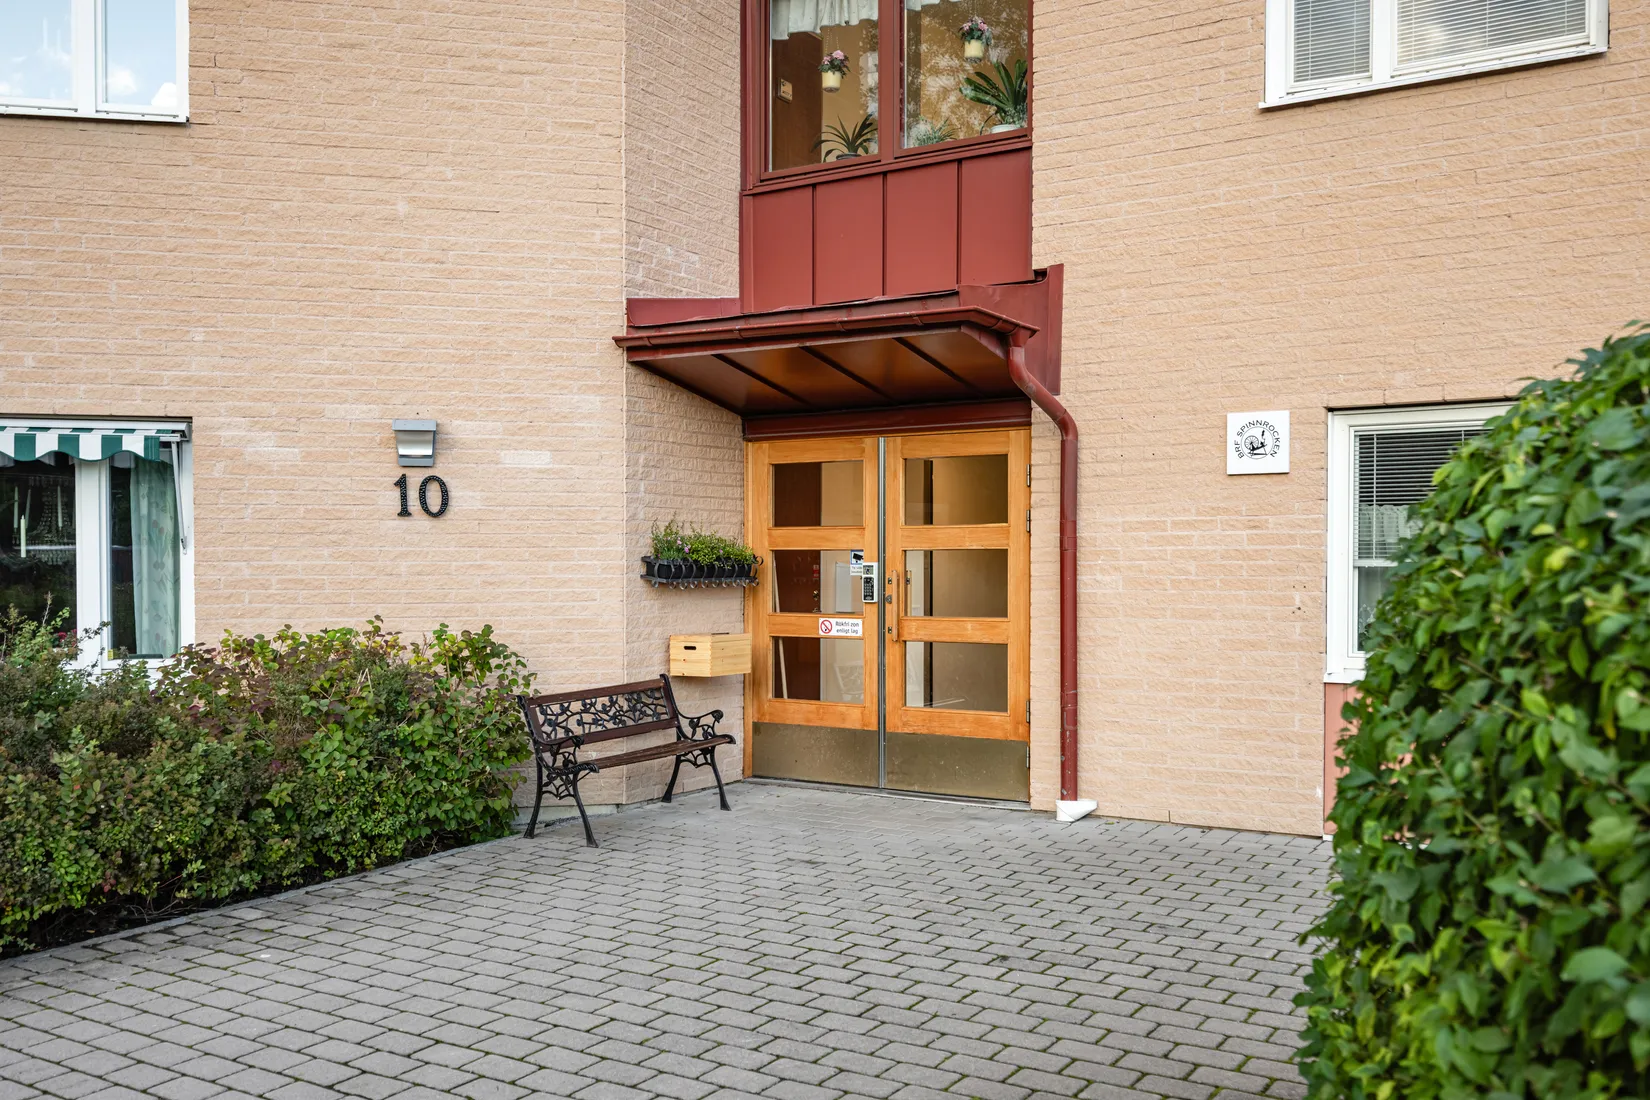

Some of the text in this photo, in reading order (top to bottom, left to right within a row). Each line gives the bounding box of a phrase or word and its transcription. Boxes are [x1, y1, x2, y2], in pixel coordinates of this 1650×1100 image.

[1234, 420, 1280, 459] BRF SPINNROCKEN
[394, 473, 449, 518] 10
